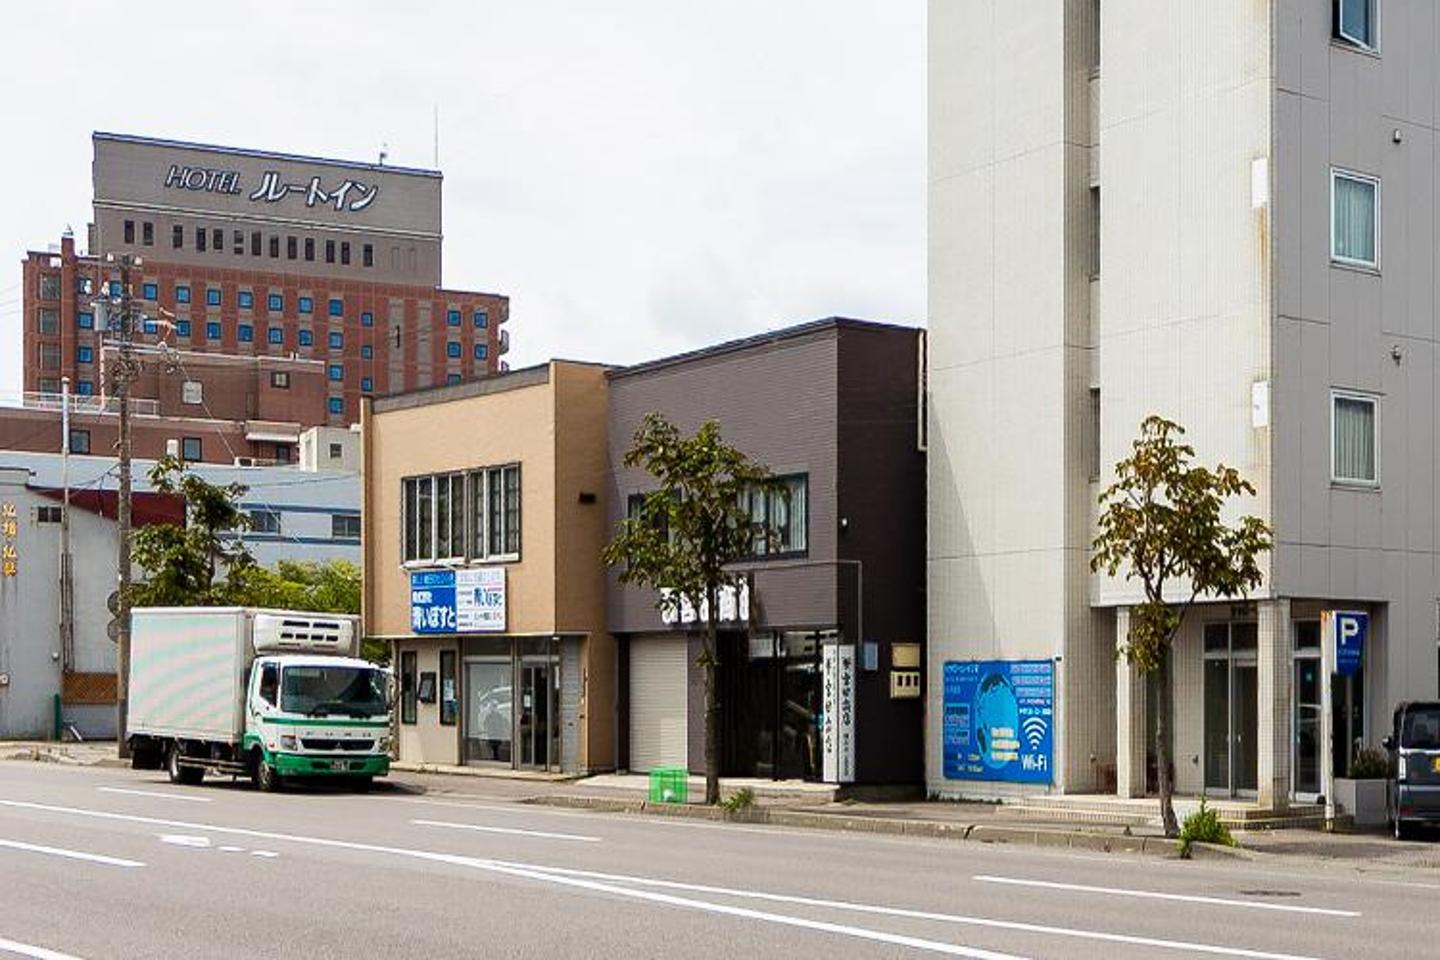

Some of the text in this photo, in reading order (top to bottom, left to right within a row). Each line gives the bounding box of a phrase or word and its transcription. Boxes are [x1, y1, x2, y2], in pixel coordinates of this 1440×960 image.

[165, 164, 243, 195] HOTEL
[249, 171, 379, 212] ルートイン
[1341, 617, 1360, 646] P
[1021, 753, 1048, 773] Wi-Fi
